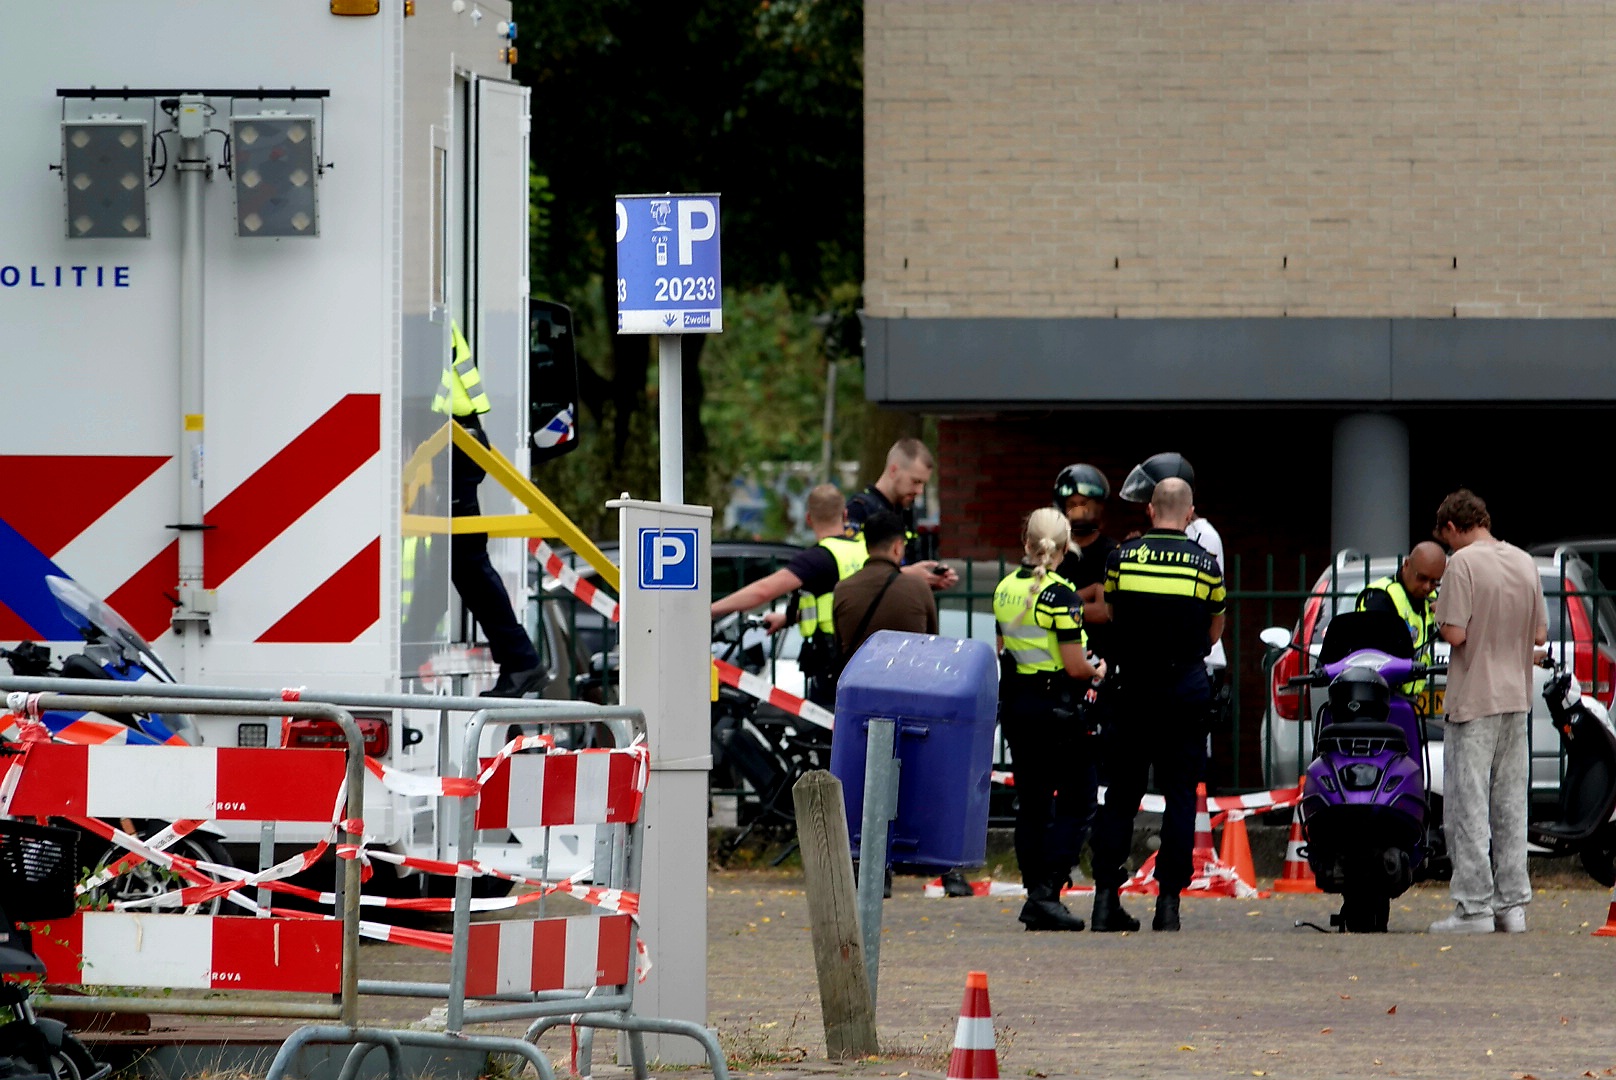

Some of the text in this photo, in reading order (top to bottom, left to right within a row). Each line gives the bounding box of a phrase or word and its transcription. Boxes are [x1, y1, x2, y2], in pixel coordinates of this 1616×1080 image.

[678, 200, 716, 265] P
[0, 266, 129, 287] OLITIE
[655, 277, 716, 302] 20233
[684, 315, 710, 325] Zwolle
[653, 536, 686, 580] P
[1129, 544, 1191, 564] POLITIE
[217, 801, 247, 811] ROVA
[211, 971, 241, 981] ROVA
